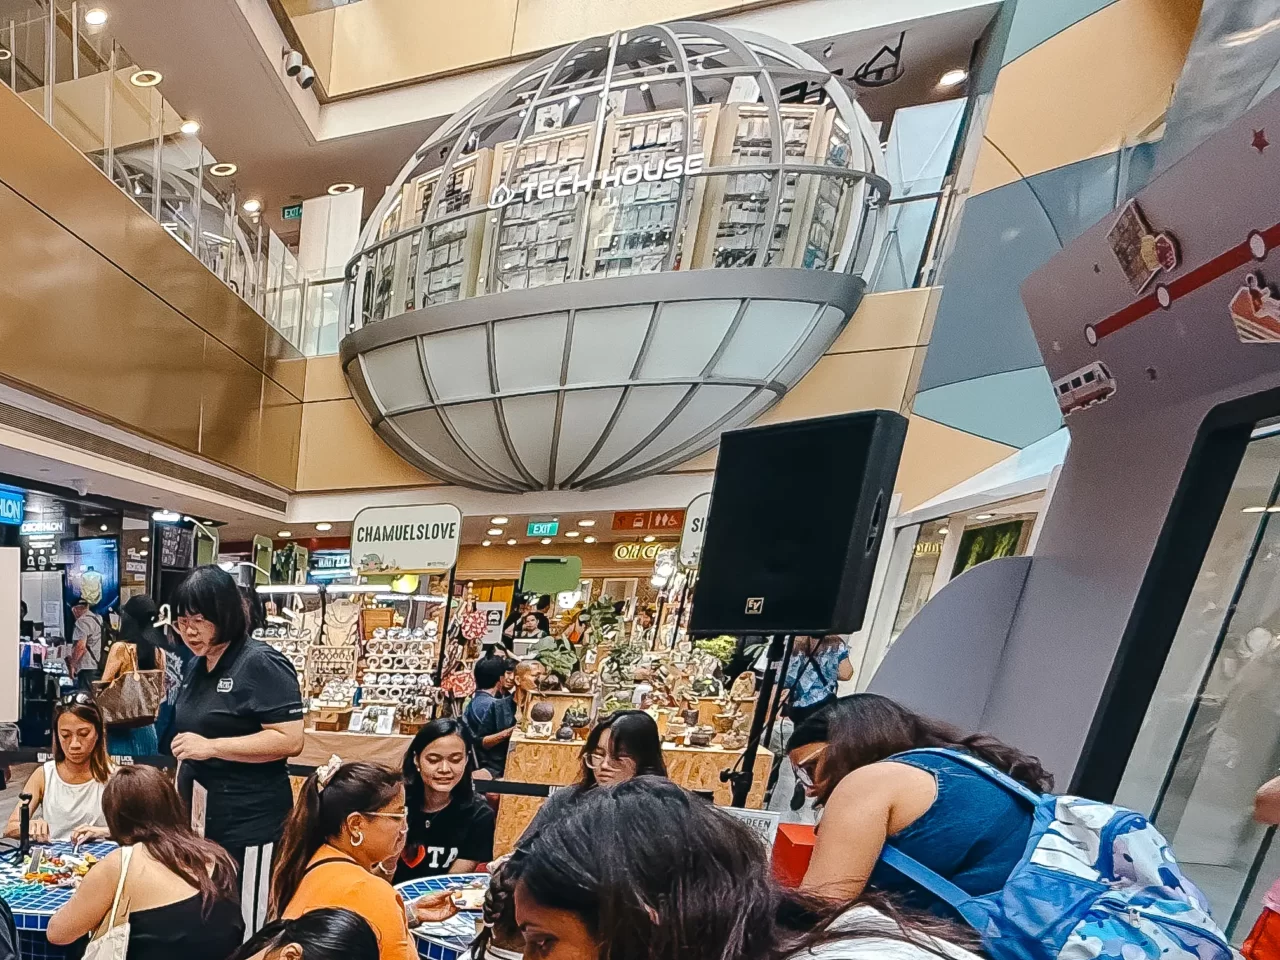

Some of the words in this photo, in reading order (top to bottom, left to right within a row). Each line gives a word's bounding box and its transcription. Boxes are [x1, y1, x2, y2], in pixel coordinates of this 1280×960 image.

[520, 172, 594, 202] TECH
[601, 153, 704, 190] HOUSE
[285, 206, 300, 217] EXIT
[356, 522, 457, 543] CHAMUELSLOVE
[533, 523, 552, 534] EXIT
